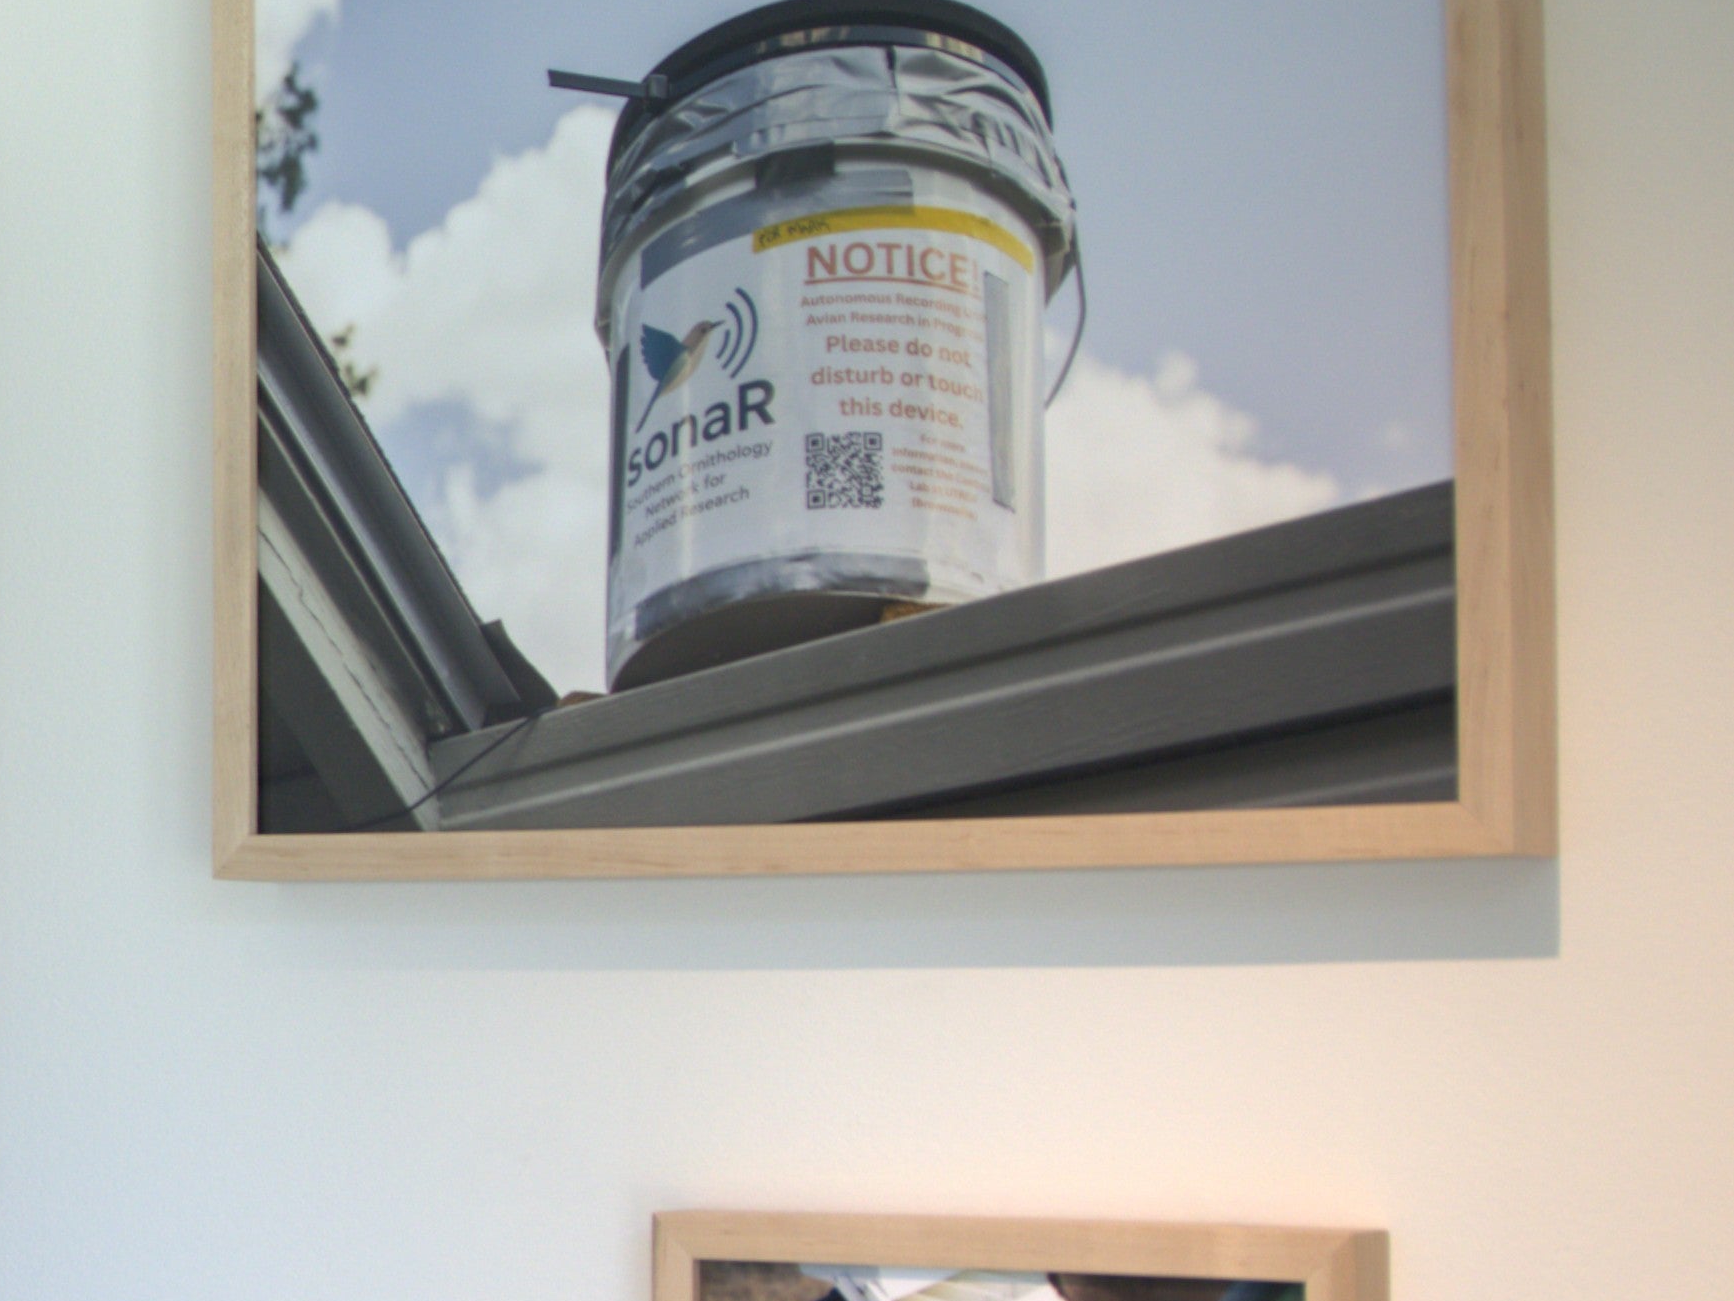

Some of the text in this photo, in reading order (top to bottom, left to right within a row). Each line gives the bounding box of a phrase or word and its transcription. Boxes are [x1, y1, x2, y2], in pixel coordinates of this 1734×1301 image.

[801, 293, 891, 308] Autonomous
[896, 293, 962, 317] Recording
[806, 313, 846, 326] Avian
[850, 311, 915, 326] Research
[918, 314, 930, 328] in
[826, 334, 972, 368] Please do not
[810, 365, 984, 402] disturb or touch
[839, 396, 964, 429] this device.
[626, 379, 776, 488] sonaR
[645, 472, 726, 518] Netwk for
